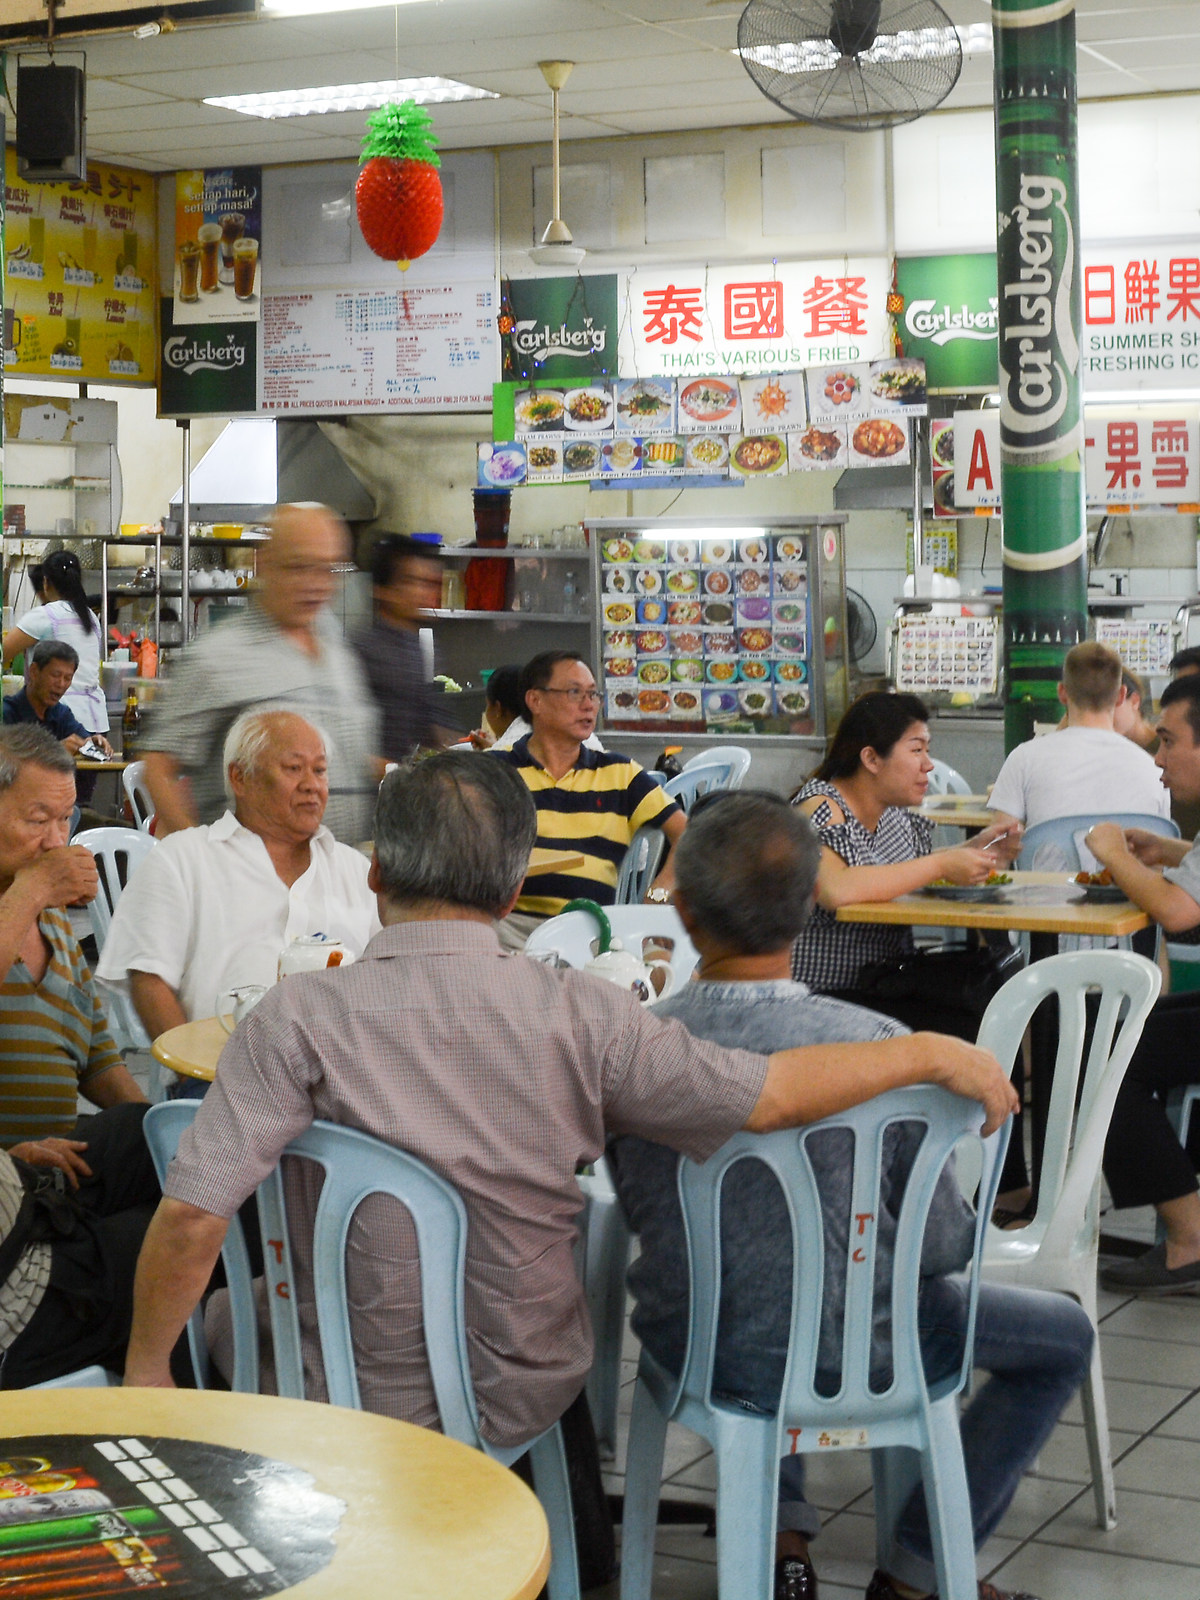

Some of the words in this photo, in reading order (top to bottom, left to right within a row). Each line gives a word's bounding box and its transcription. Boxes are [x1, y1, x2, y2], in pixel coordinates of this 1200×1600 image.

[642, 275, 868, 345] 泰國餐
[905, 299, 998, 339] Carlsber
[999, 173, 1067, 433] Carlsberg
[164, 336, 246, 368] Carlsberg
[513, 320, 606, 354] Carlsberg
[1090, 332, 1174, 351] SUMMER
[660, 351, 715, 367] THAI'S
[721, 348, 800, 365] VARIOUS
[808, 346, 860, 362] FRIED
[1086, 420, 1189, 489] 果雪
